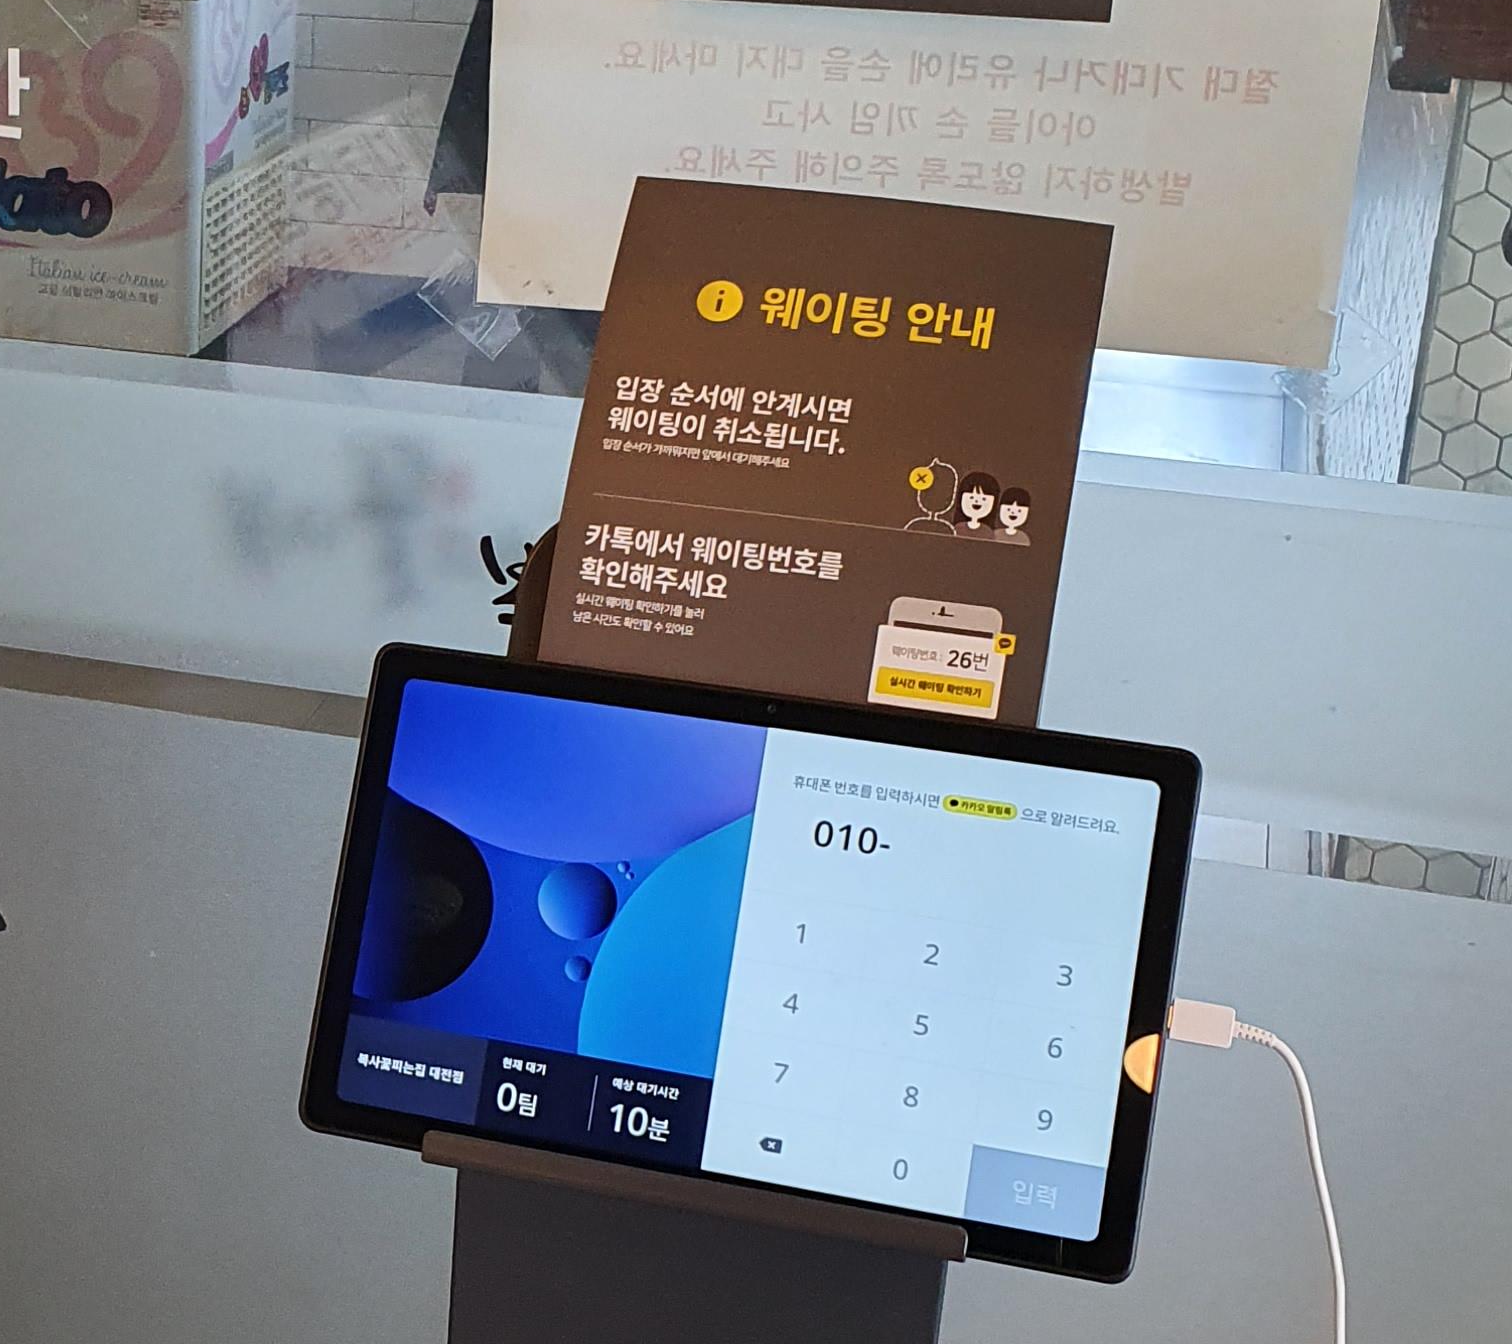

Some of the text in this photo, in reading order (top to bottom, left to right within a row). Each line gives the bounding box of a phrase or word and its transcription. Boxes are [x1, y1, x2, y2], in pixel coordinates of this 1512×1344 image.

[759, 287, 995, 350] 웨이팅 안내
[616, 375, 853, 424] 입장 순서에 안계시면
[607, 407, 846, 456] 웨이팅이 취소됩니다.
[584, 523, 844, 581] 카톡에서 웨이팅번호를
[579, 556, 729, 600] 확인해주세요
[573, 610, 694, 636] 남은 시간도 확인할 수 있어요
[575, 592, 705, 620] 실시간 웨이팅 확인하기를 눌러
[946, 649, 989, 673] 26번
[889, 675, 982, 699] 실시간 웨이팅 확인하기
[793, 775, 832, 793] 휴대폰
[834, 780, 872, 799] 번호를
[875, 786, 940, 809] 입력하시면
[1020, 807, 1048, 824] 으로
[1050, 811, 1121, 836] 알려드려요.
[814, 819, 892, 855] 010-
[796, 923, 1074, 987] 1 2 3
[781, 993, 1064, 1059] 4 5 6
[428, 1065, 465, 1085] 대전점
[502, 1056, 547, 1076] 현재 대기
[496, 1081, 539, 1118] 0팀
[611, 1076, 680, 1102] 예상 대기시간
[773, 1062, 1054, 1131] 7 8 9
[609, 1103, 671, 1143] 10분
[892, 1158, 909, 1181] 0
[1011, 1179, 1059, 1210] 입력
